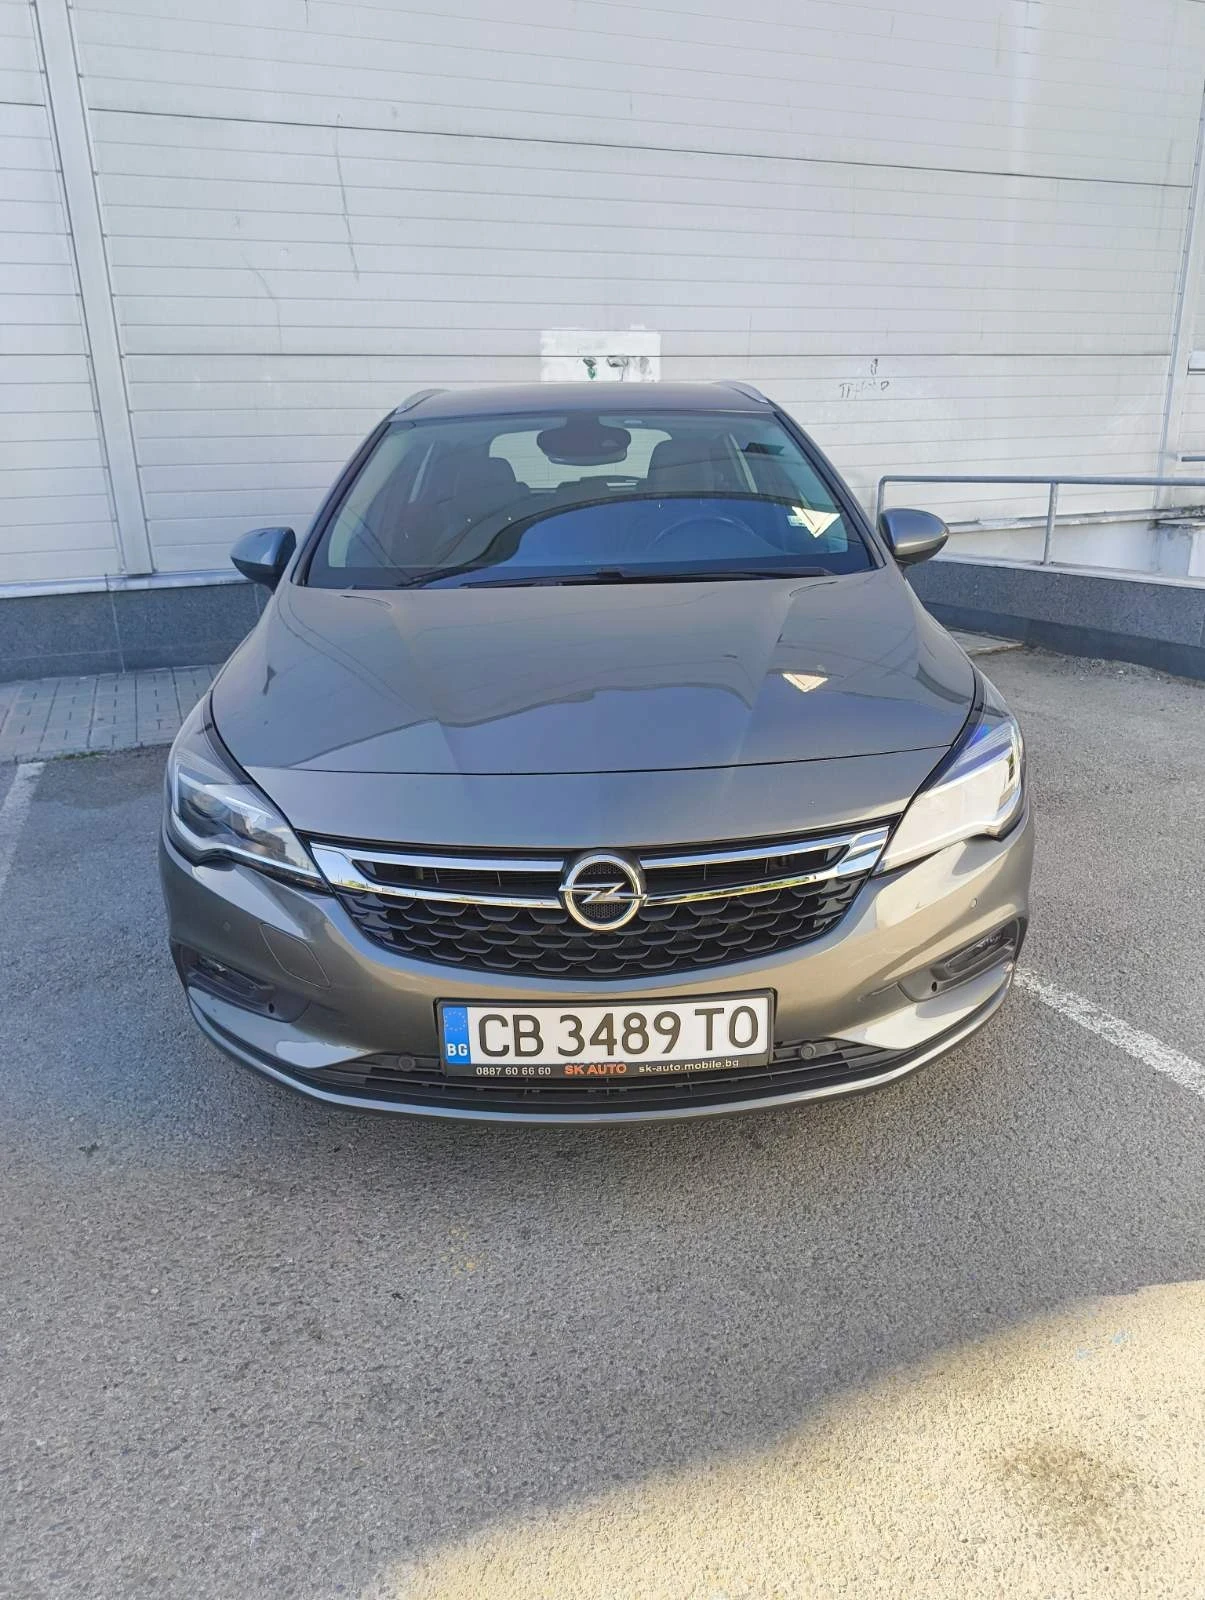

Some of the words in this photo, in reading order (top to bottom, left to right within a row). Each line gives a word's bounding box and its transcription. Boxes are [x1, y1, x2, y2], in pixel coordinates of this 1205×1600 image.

[478, 1013, 544, 1057] CB
[557, 1010, 681, 1057] 3489
[694, 1005, 759, 1051] TO
[447, 1043, 468, 1057] BG
[476, 1067, 501, 1076] 0887
[505, 1066, 518, 1076] 60
[521, 1066, 535, 1076] 66
[538, 1066, 551, 1076] 60
[564, 1064, 584, 1075] SK
[586, 1063, 627, 1075] AUTO
[638, 1058, 739, 1073] sk-auto.mobile.bg
